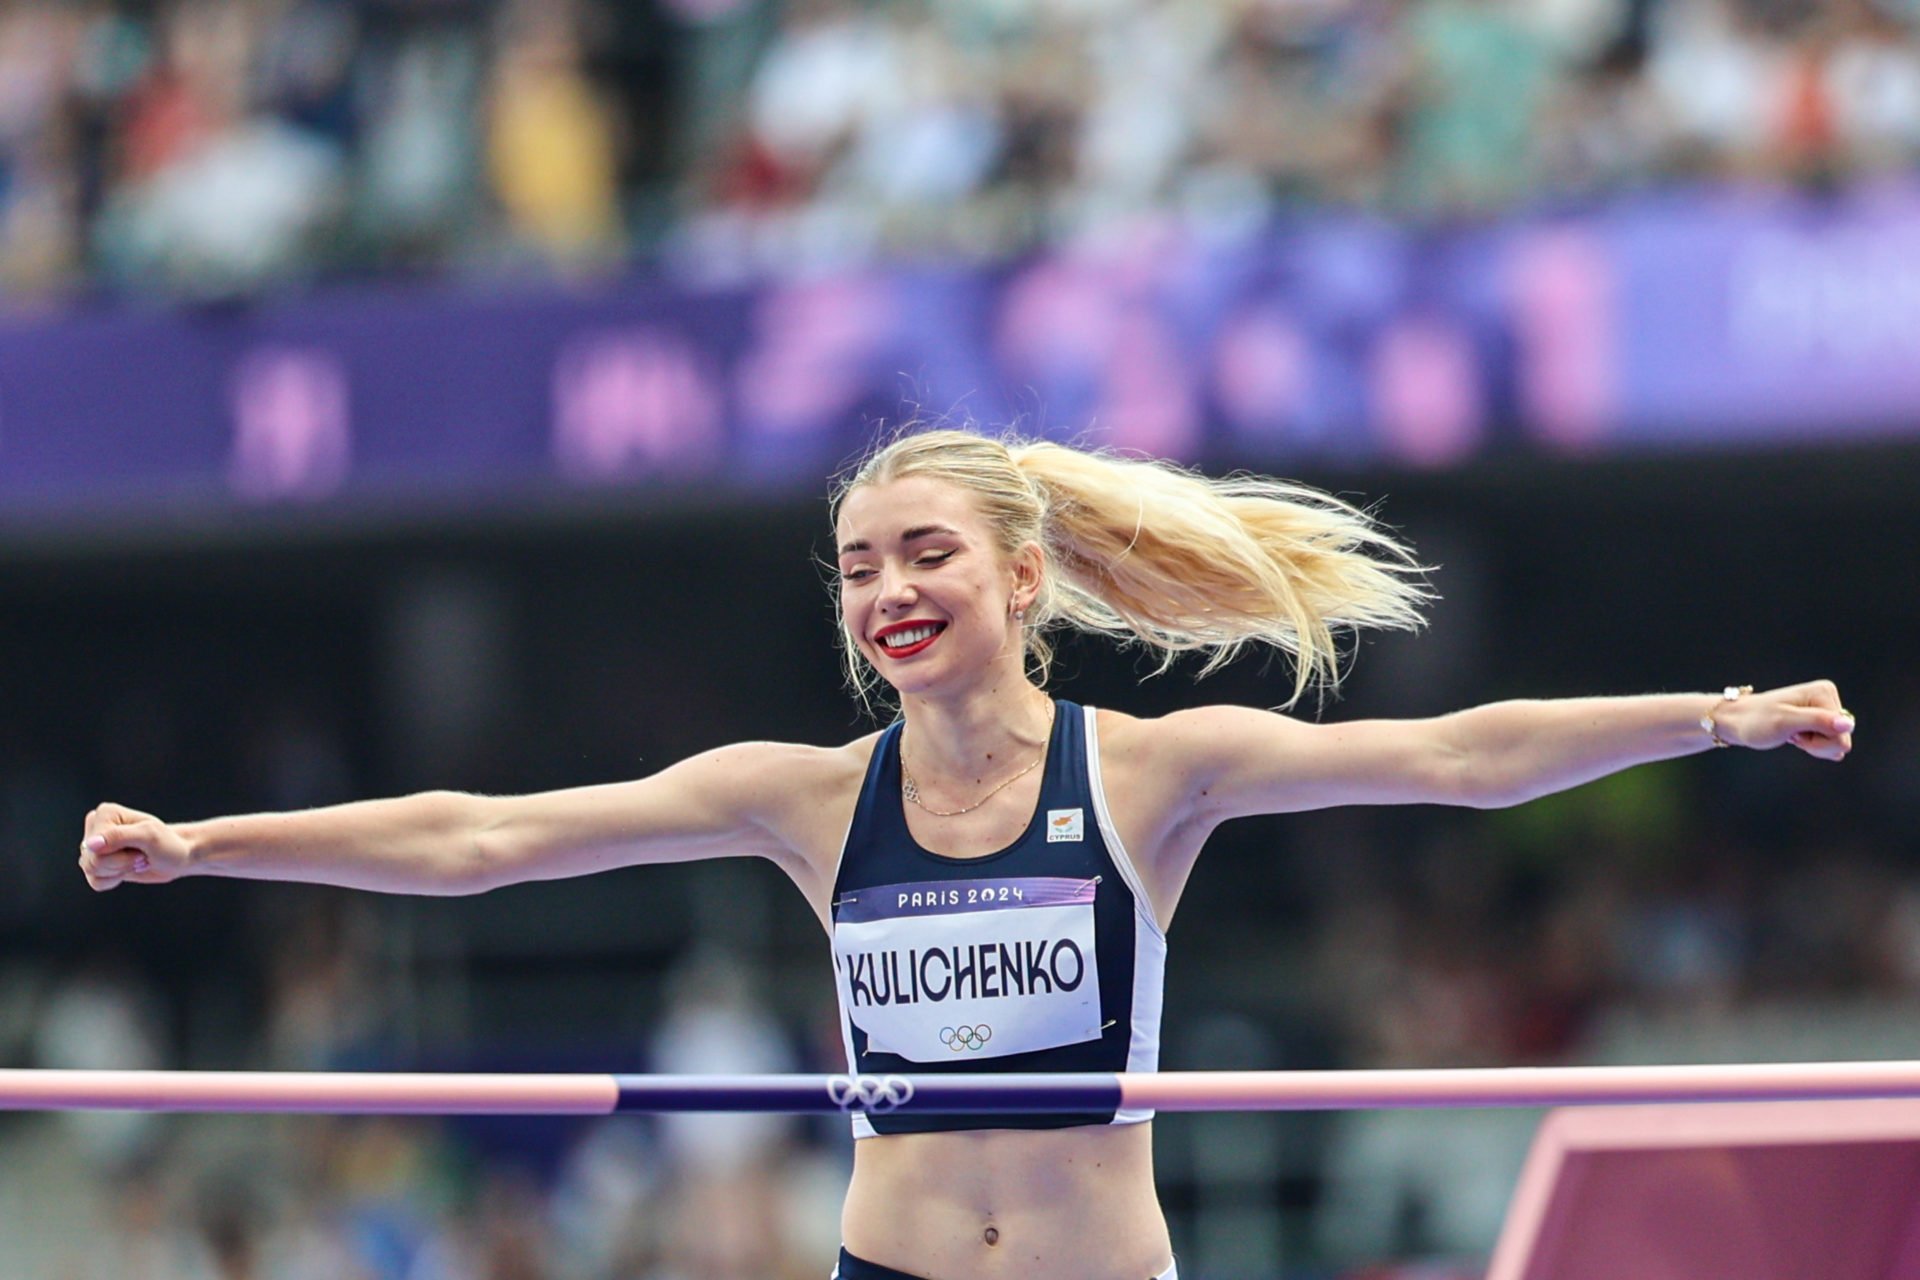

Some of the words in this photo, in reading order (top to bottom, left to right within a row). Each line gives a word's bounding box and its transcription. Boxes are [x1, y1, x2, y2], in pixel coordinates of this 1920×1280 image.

[898, 890, 959, 908] PARIS
[967, 887, 1023, 904] 2024
[846, 938, 1084, 1007] KULICHENKO
